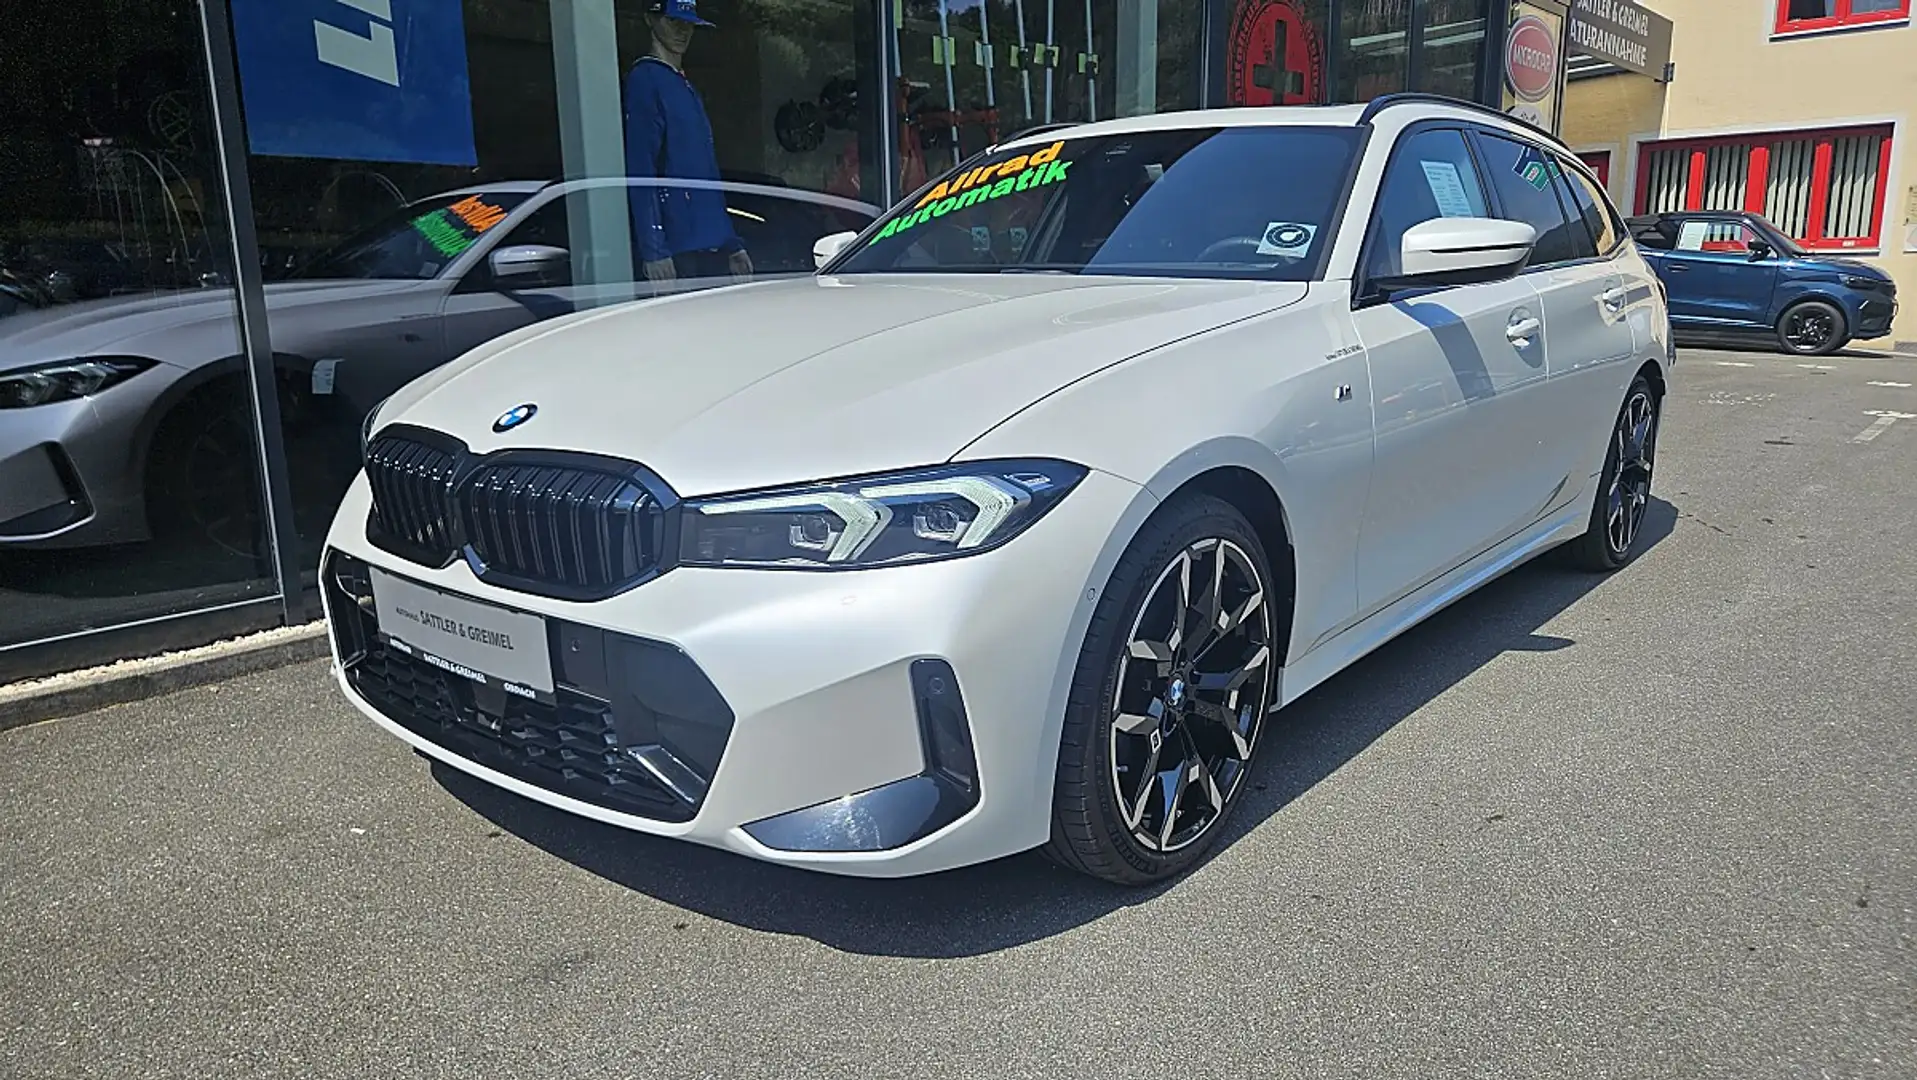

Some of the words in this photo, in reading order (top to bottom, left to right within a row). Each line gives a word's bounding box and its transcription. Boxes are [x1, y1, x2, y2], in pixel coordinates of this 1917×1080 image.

[1612, 1, 1618, 22] &
[914, 140, 1065, 208] Allrad
[868, 159, 1073, 246] Automatik
[420, 610, 458, 637] SATTLER
[459, 622, 466, 638] &
[468, 625, 514, 650] GREIMEL
